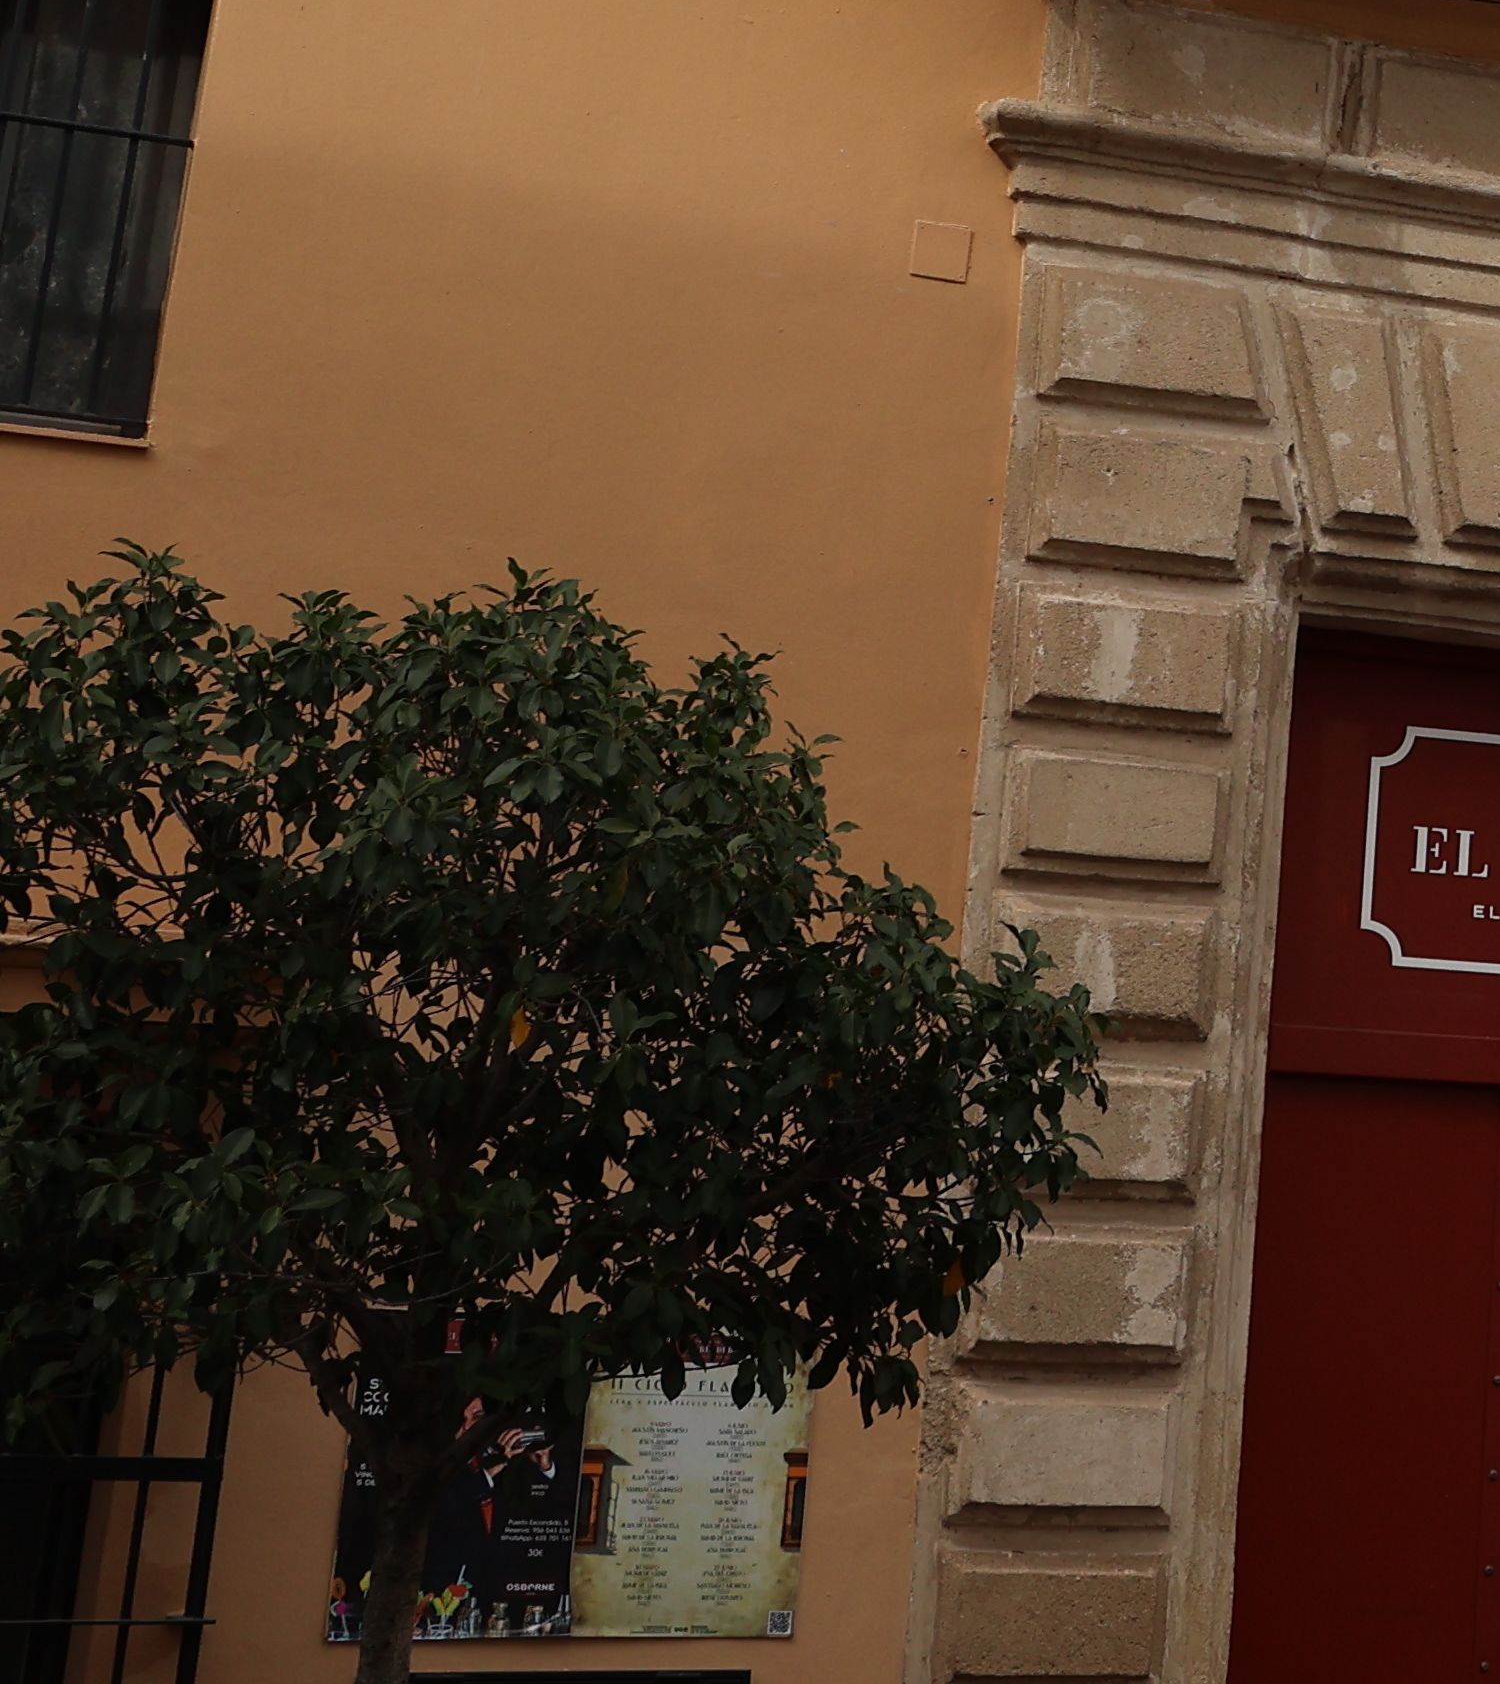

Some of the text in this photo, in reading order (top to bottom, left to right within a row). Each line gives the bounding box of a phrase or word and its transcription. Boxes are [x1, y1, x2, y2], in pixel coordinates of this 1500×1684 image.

[1410, 825, 1489, 878] EL
[1473, 904, 1500, 920] EL
[506, 1583, 555, 1591] OSBORNE
